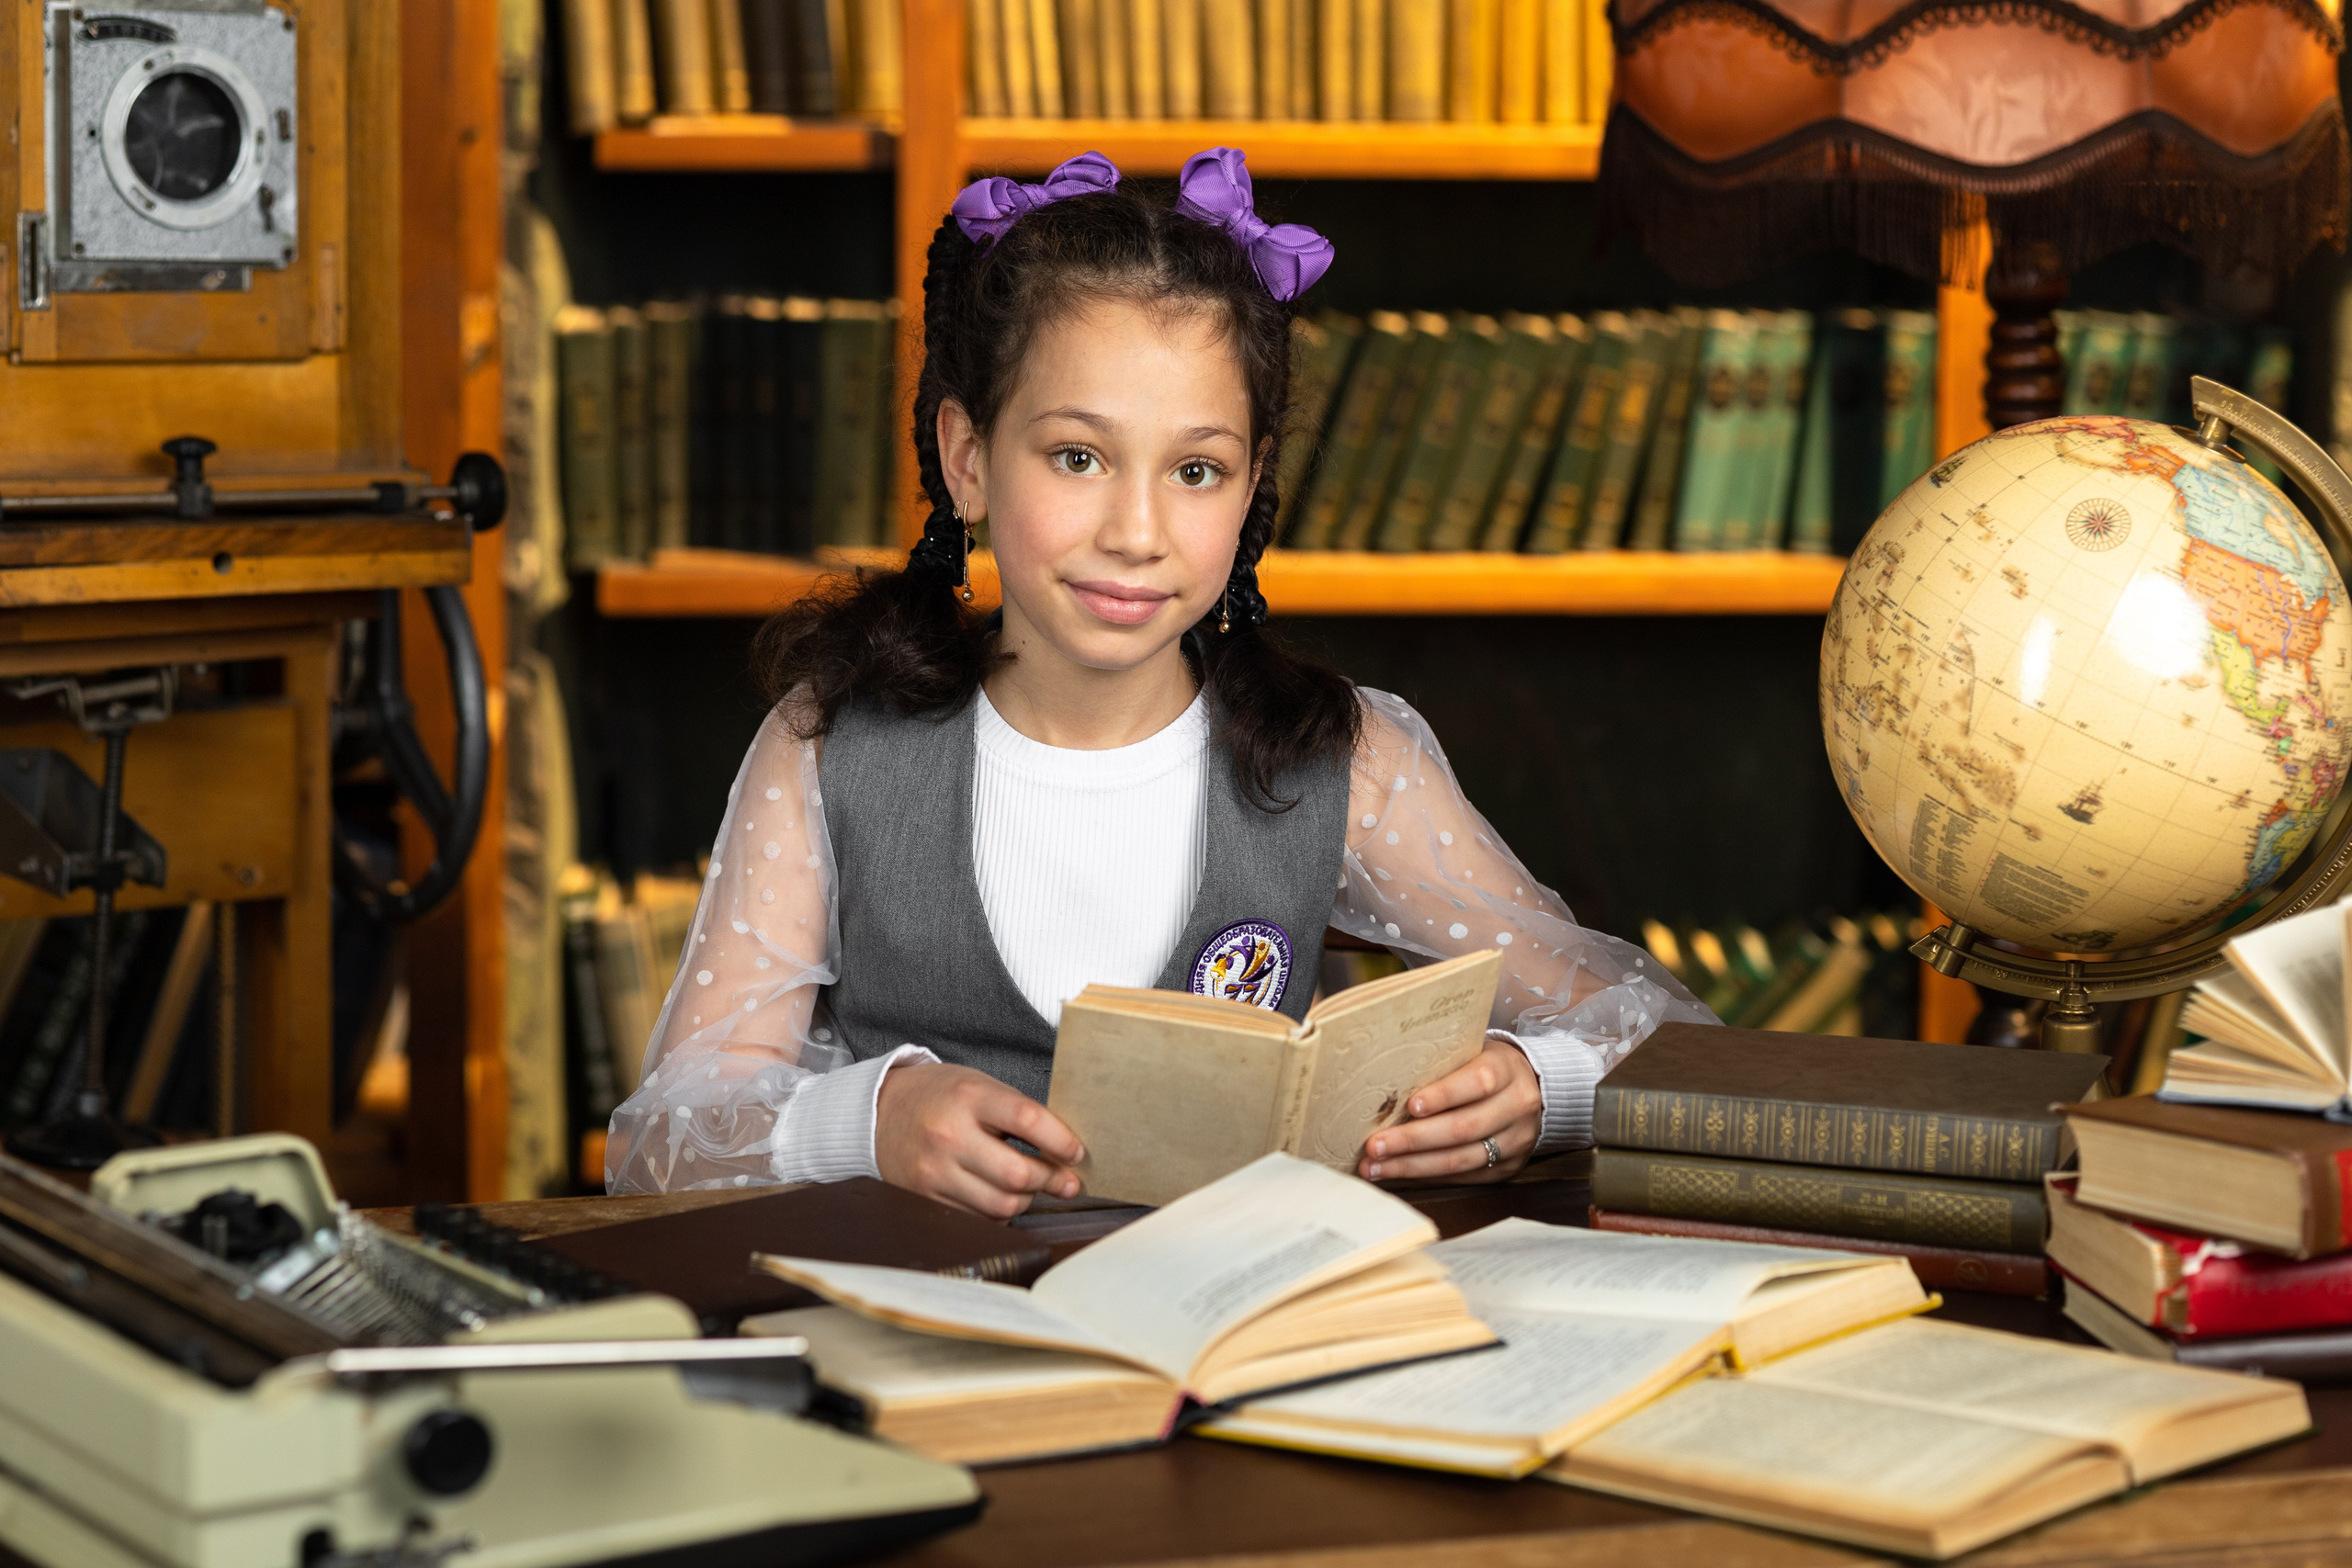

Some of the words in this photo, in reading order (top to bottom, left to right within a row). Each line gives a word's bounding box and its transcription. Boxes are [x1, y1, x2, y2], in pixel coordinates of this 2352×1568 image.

[1194, 964, 1207, 995] ДНЯЯ
[1204, 926, 1288, 968] ОБЩЕОБРАЗОВАТЕЛЬНАЯ
[1269, 970, 1286, 1007] ШКОЛА
